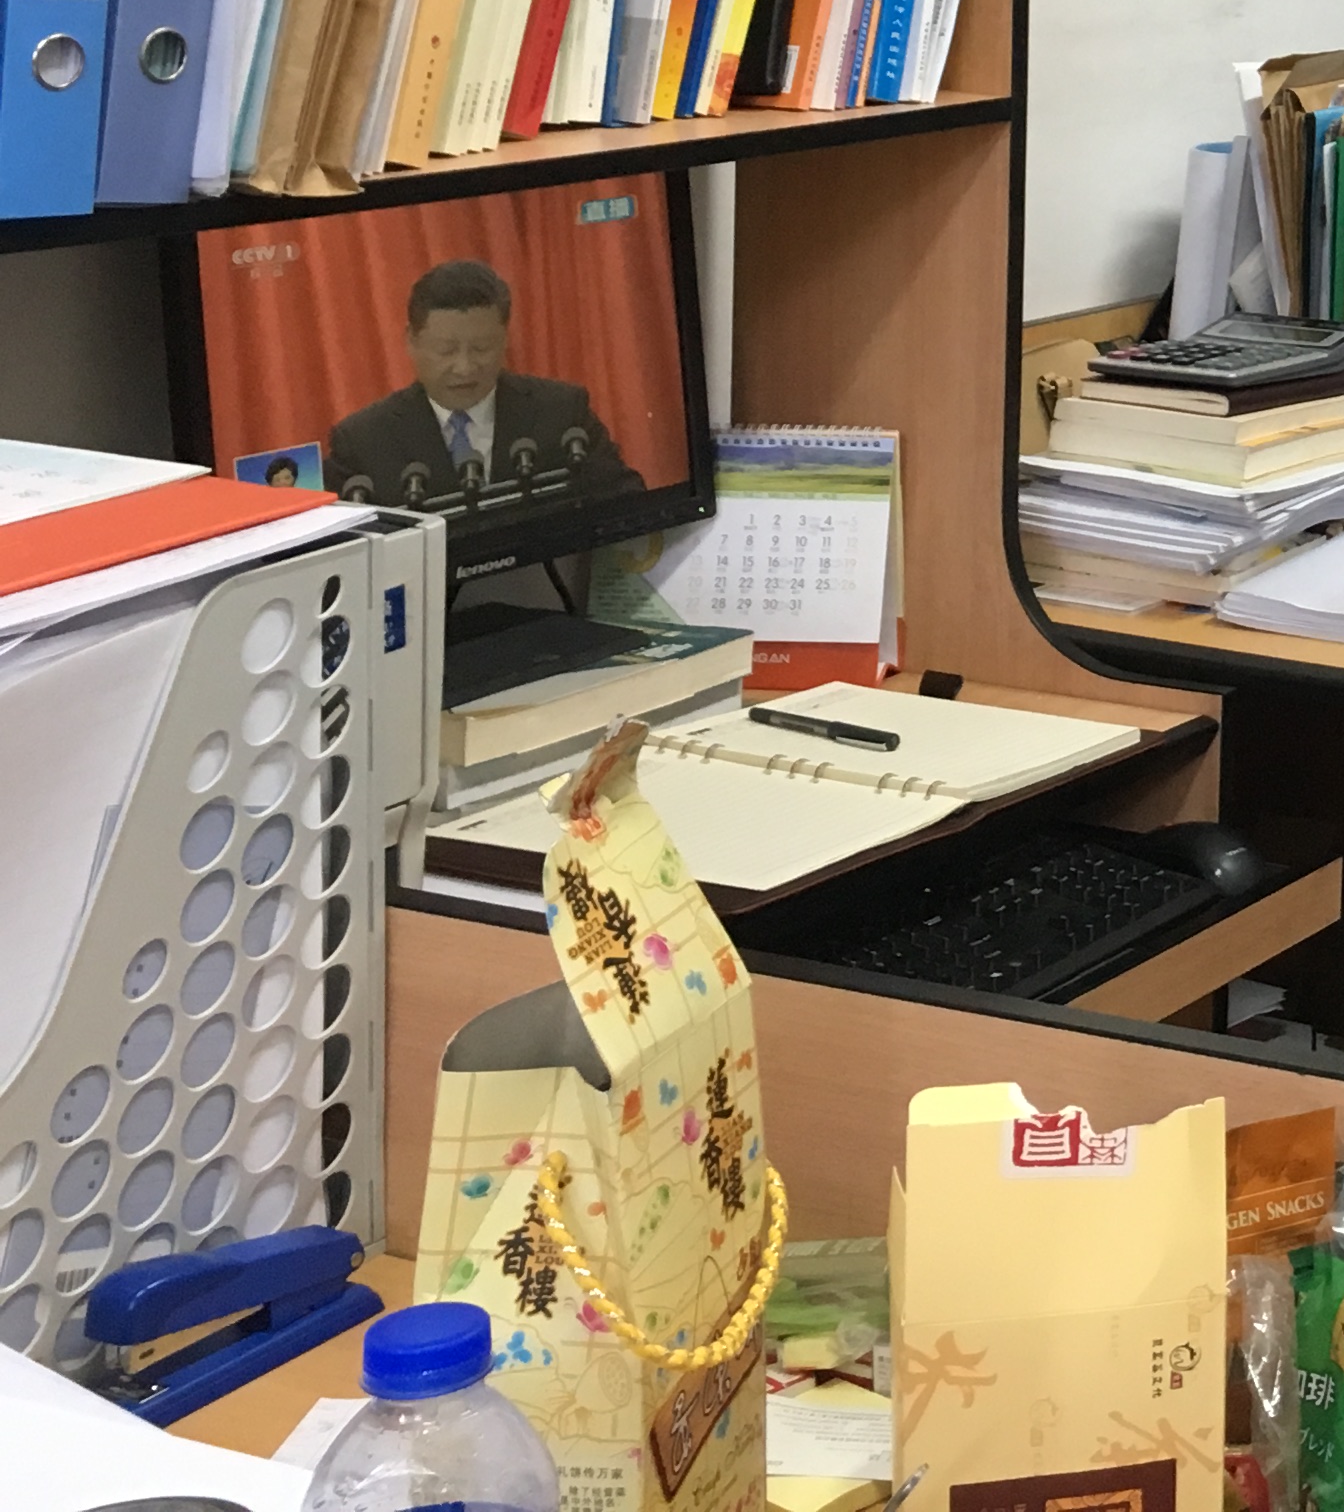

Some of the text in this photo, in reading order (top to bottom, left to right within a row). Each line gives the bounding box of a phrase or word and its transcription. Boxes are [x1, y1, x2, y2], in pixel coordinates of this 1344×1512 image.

[231, 245, 277, 265] CCTV
[750, 514, 755, 524] 1
[773, 515, 781, 525] 2
[800, 515, 806, 526] 3
[824, 516, 832, 526] 4
[721, 534, 728, 545] 7
[746, 535, 753, 546] 8
[772, 536, 779, 546] 9
[795, 536, 808, 547] 10
[822, 537, 831, 547] 11
[456, 556, 516, 579] lenovo
[717, 555, 728, 566] 14
[743, 556, 753, 567] 15
[768, 557, 779, 567] 16
[794, 557, 805, 568] 17
[819, 558, 831, 568] 18
[715, 577, 726, 587] 21
[739, 577, 753, 588] 22
[765, 578, 779, 588] 23
[791, 578, 804, 589] 24
[816, 578, 830, 590] 25
[711, 598, 726, 608] 28
[737, 598, 751, 609] 29
[763, 599, 778, 610] 30
[789, 600, 802, 610] 31
[576, 917, 601, 939] LOU
[567, 928, 608, 960] XIANG
[584, 939, 613, 965] LIAN
[1266, 1191, 1325, 1221] SNACKS
